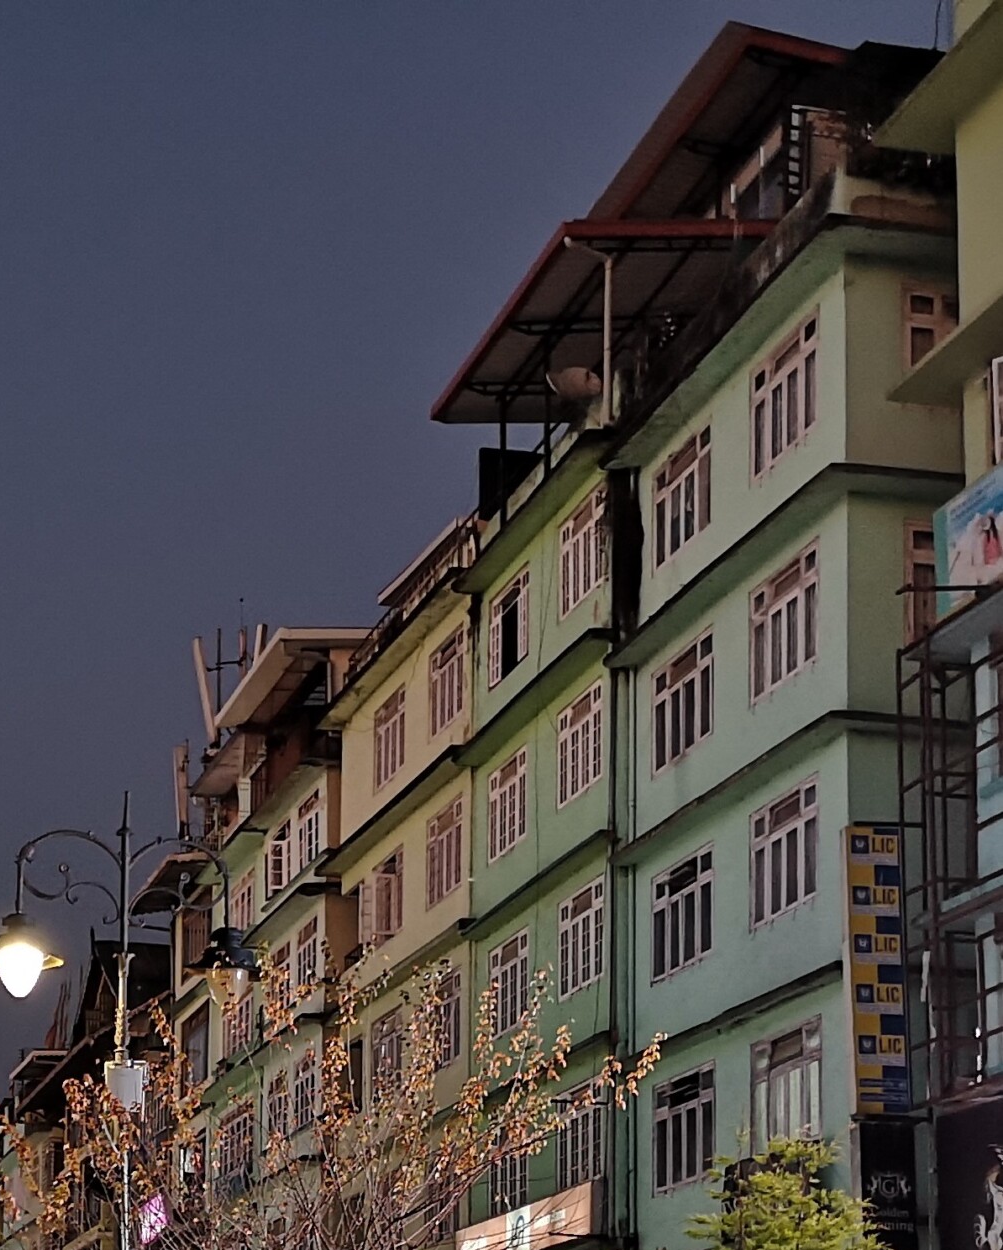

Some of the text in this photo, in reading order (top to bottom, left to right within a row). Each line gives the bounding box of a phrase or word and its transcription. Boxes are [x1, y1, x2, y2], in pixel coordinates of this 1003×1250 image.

[871, 836, 896, 854] LIC
[872, 887, 896, 905] LIC
[874, 936, 898, 954] LIC
[876, 985, 900, 1004] LIC
[879, 1036, 902, 1055] LIC
